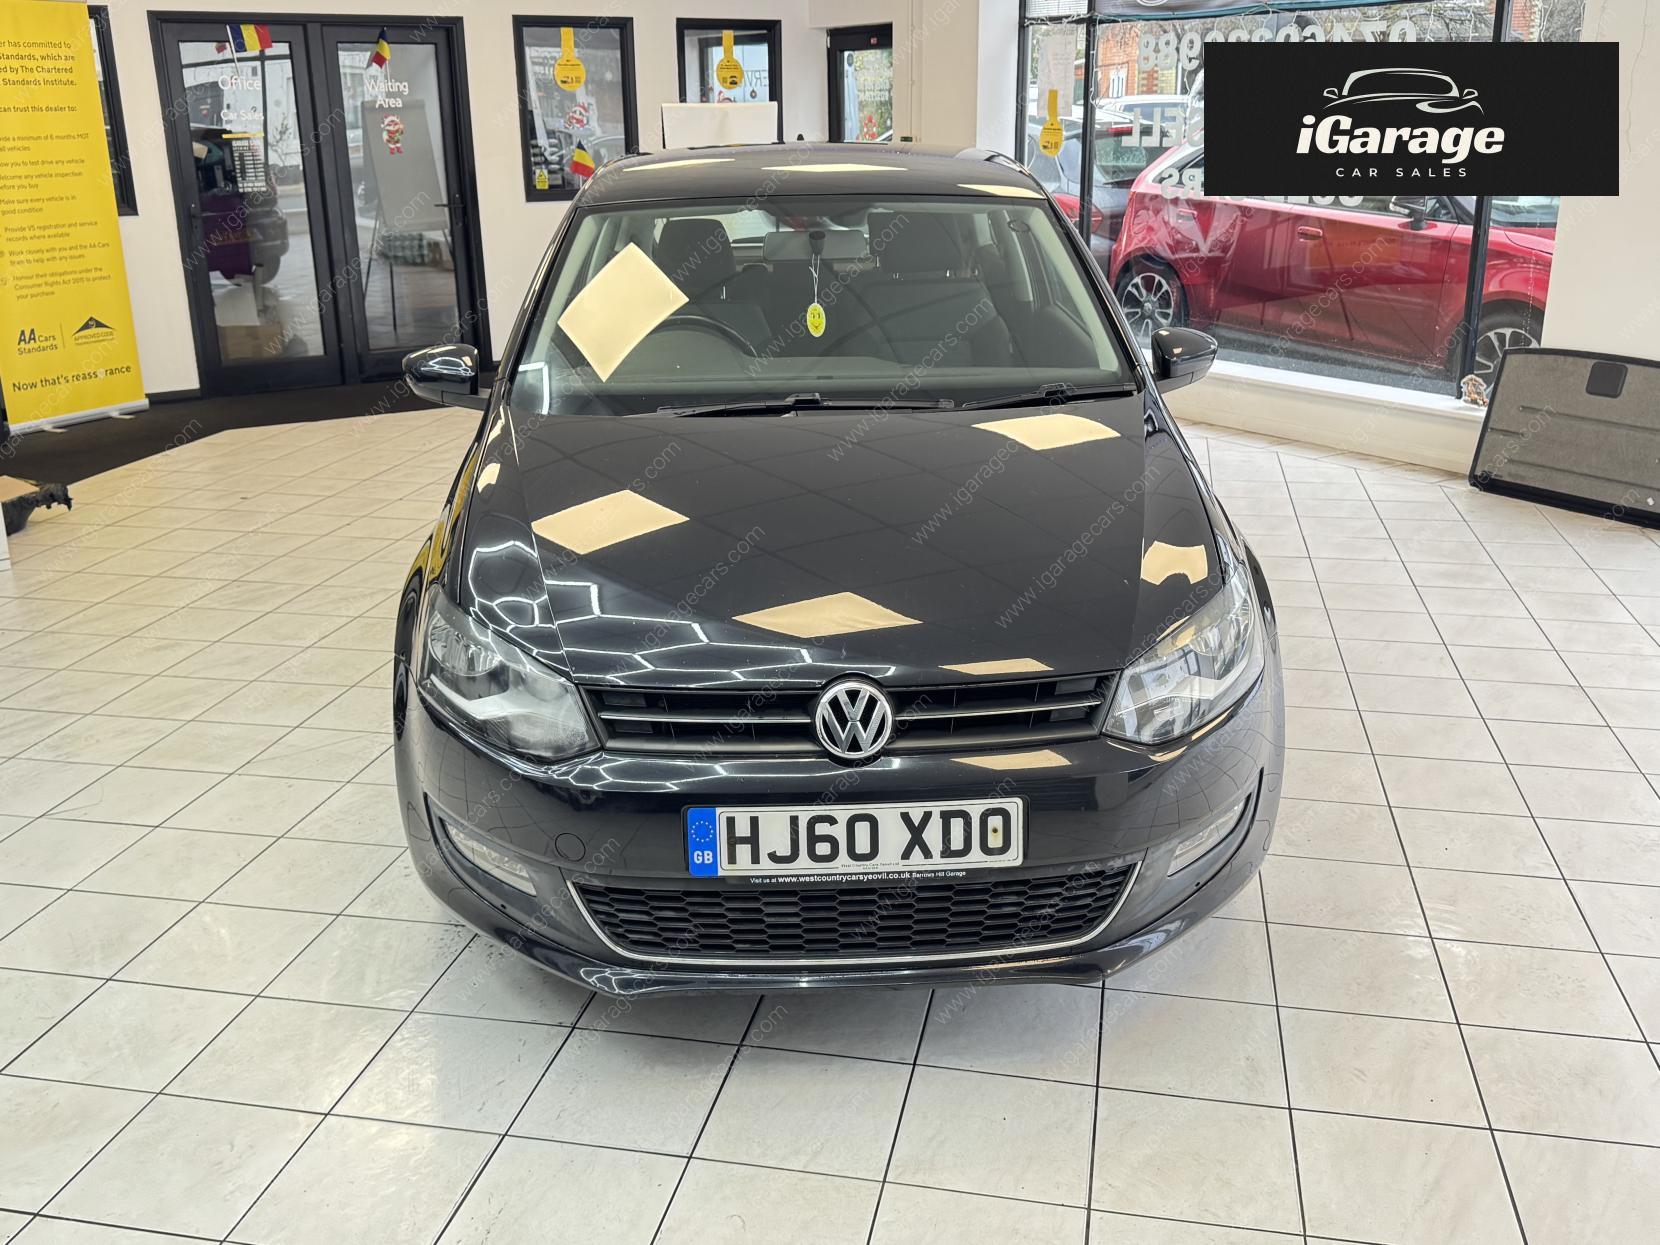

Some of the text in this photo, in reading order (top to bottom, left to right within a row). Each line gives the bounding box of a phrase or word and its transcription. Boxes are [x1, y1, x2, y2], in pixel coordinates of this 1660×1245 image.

[8, 40, 21, 48] has
[23, 40, 64, 48] committed
[10, 65, 18, 74] by
[20, 65, 34, 73] The
[36, 66, 73, 74] Chartered
[218, 75, 262, 91] Office
[364, 78, 409, 96] Waiting
[375, 96, 403, 108] Area
[220, 110, 264, 120] Car Sales
[18, 328, 56, 346] AA Cars
[18, 343, 58, 356] Standards
[12, 366, 132, 392] Now that's reassrance
[725, 811, 880, 865] HJ60
[693, 849, 714, 865] GB
[778, 872, 910, 884] www.westcountrycarsyeovil.co.uk
